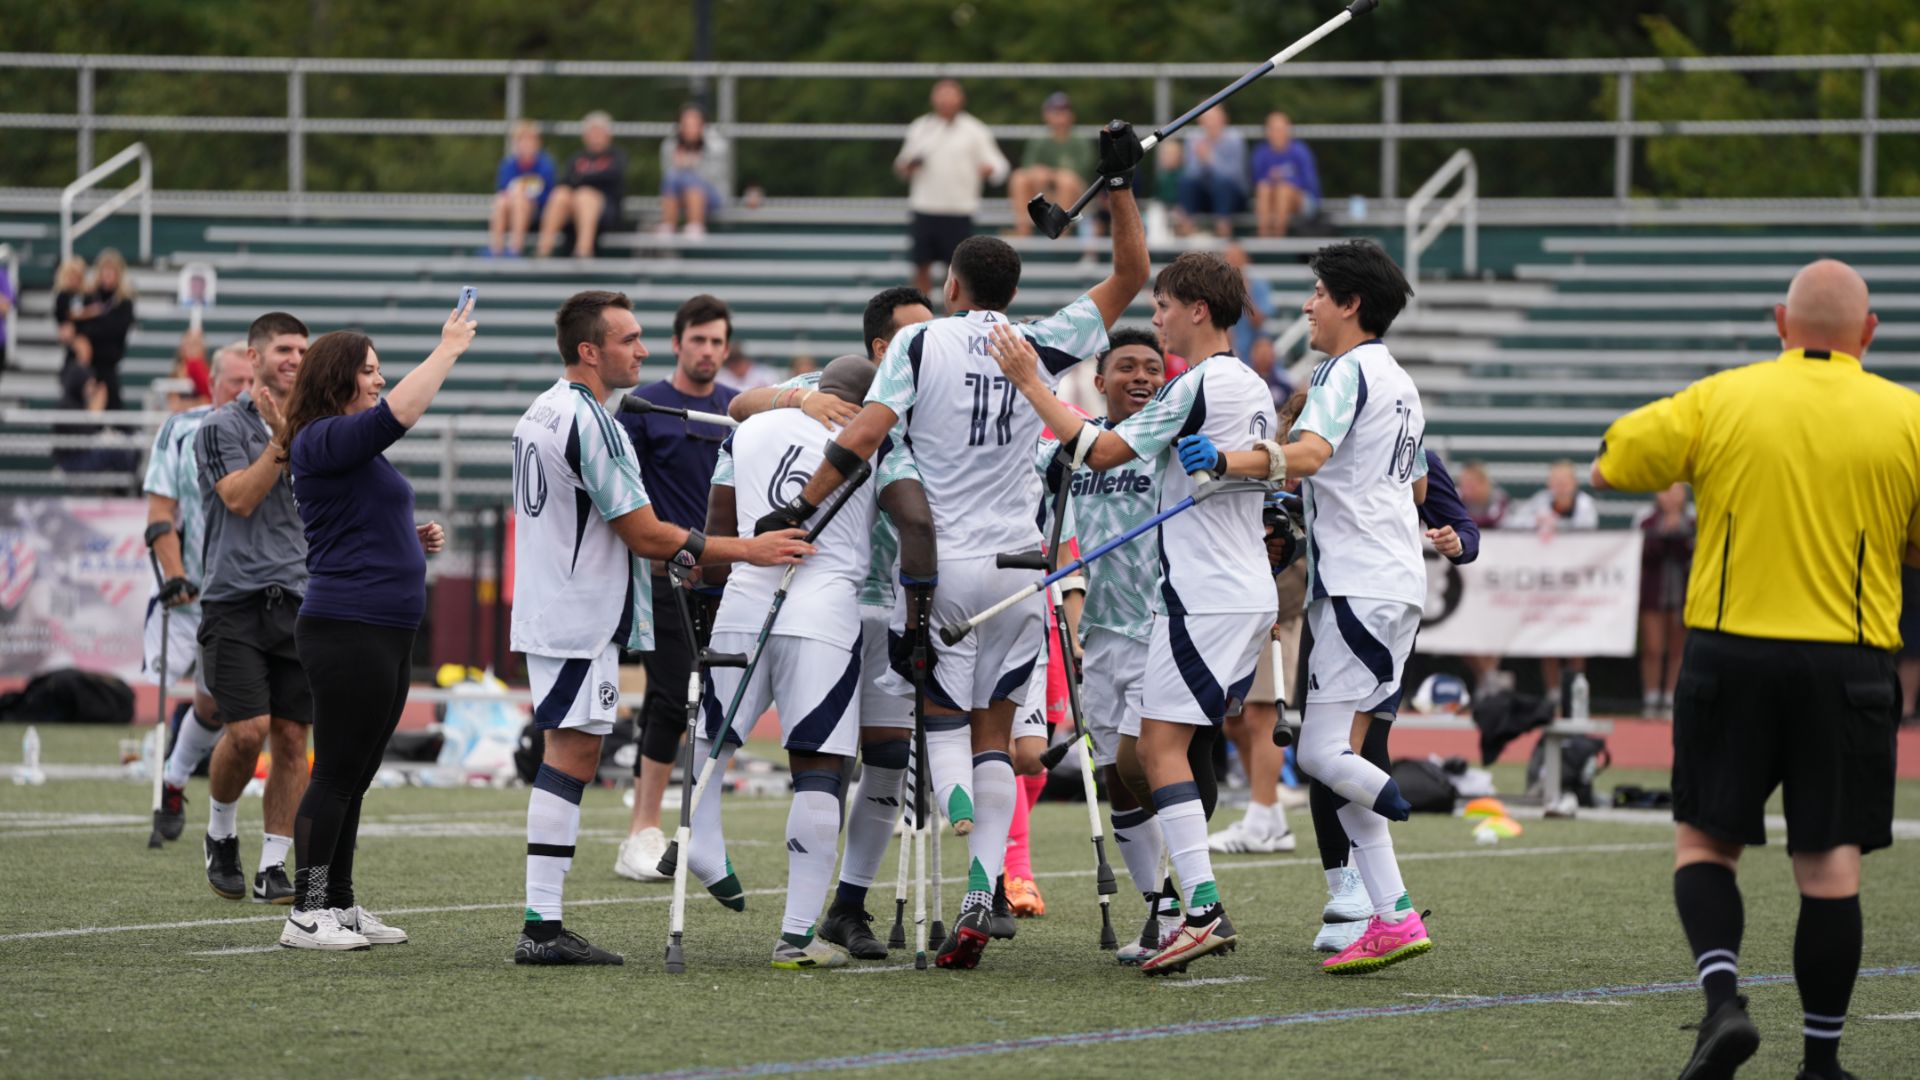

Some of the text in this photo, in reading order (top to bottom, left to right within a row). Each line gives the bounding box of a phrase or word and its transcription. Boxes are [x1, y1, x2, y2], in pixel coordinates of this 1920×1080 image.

[512, 436, 548, 518] 10
[768, 444, 813, 513] 6
[1071, 469, 1151, 497] Gillette
